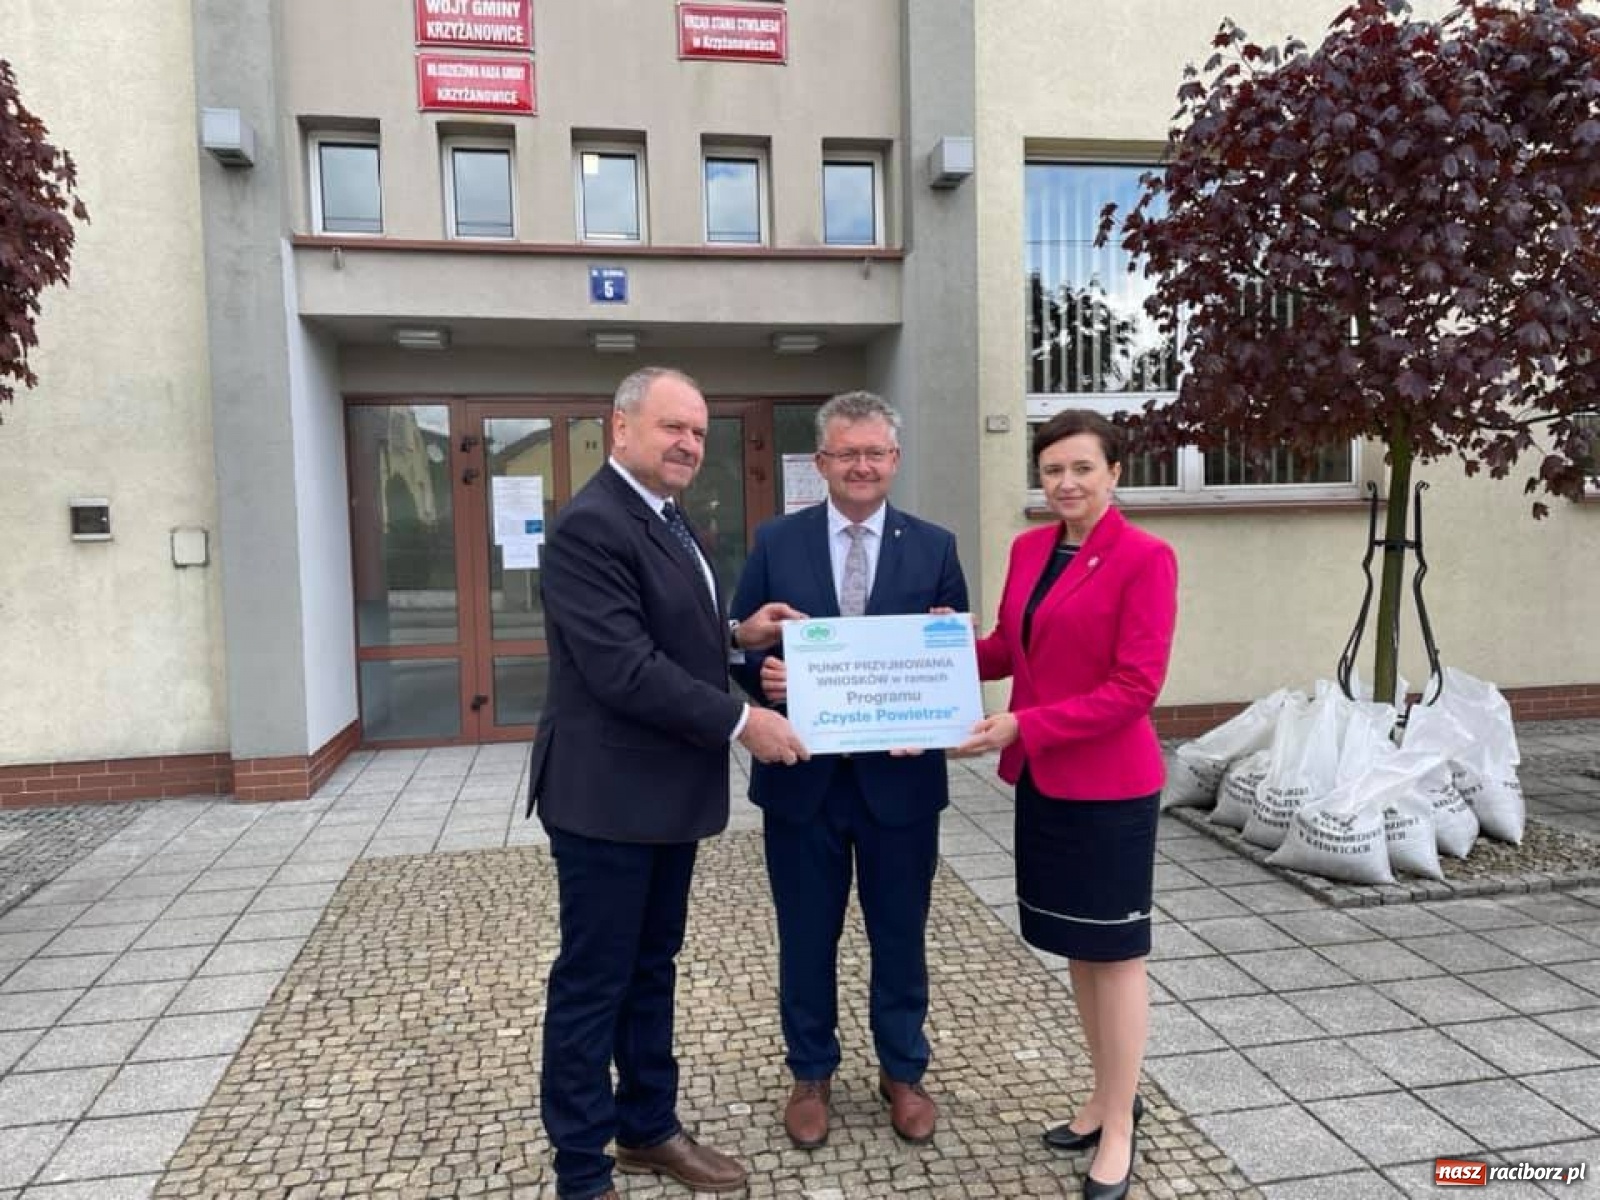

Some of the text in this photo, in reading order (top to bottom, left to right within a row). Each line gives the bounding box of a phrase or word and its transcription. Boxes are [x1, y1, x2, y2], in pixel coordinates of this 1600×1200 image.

[472, 1, 521, 18] GMINY
[426, 18, 524, 43] KRZYŻANOWICE
[604, 280, 614, 298] 5
[808, 657, 954, 673] PUNKT PRZYJMOWANIA
[816, 672, 948, 686] WNIOSKÓW w ramach
[847, 690, 921, 705] Programu
